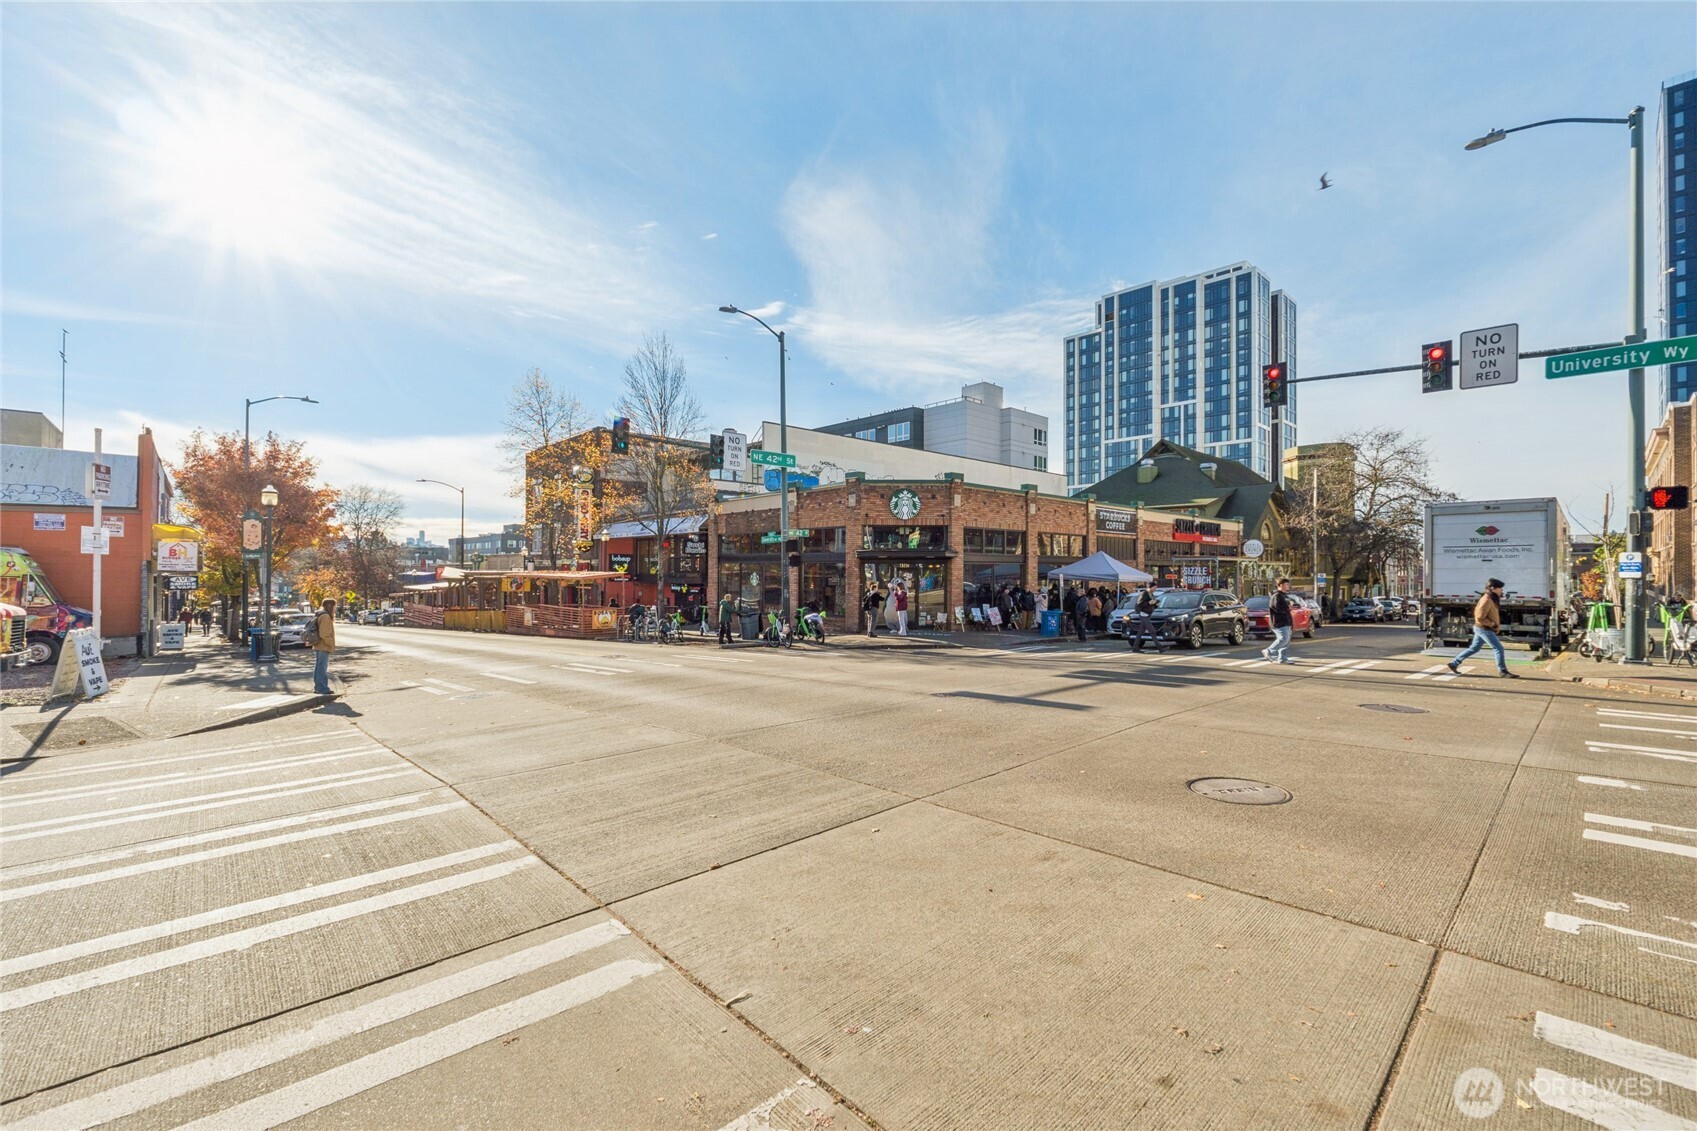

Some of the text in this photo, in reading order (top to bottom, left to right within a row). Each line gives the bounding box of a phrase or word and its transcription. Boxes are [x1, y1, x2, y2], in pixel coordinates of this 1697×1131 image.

[1475, 333, 1502, 347] NO
[1471, 346, 1505, 359] TURN
[1479, 359, 1497, 370] ON
[1551, 346, 1689, 374] University Wy
[1475, 370, 1501, 381] RED
[728, 436, 740, 445] NO
[753, 453, 763, 461] NE
[786, 457, 794, 465] St
[1099, 511, 1131, 523] STARBUCKS
[1105, 521, 1126, 530] COFFEE
[168, 548, 188, 557] BH
[1183, 566, 1208, 575] SIZZLE
[1183, 575, 1211, 584] CRUNCH
[81, 656, 101, 667] SMOKE
[88, 676, 103, 686] VAPE
